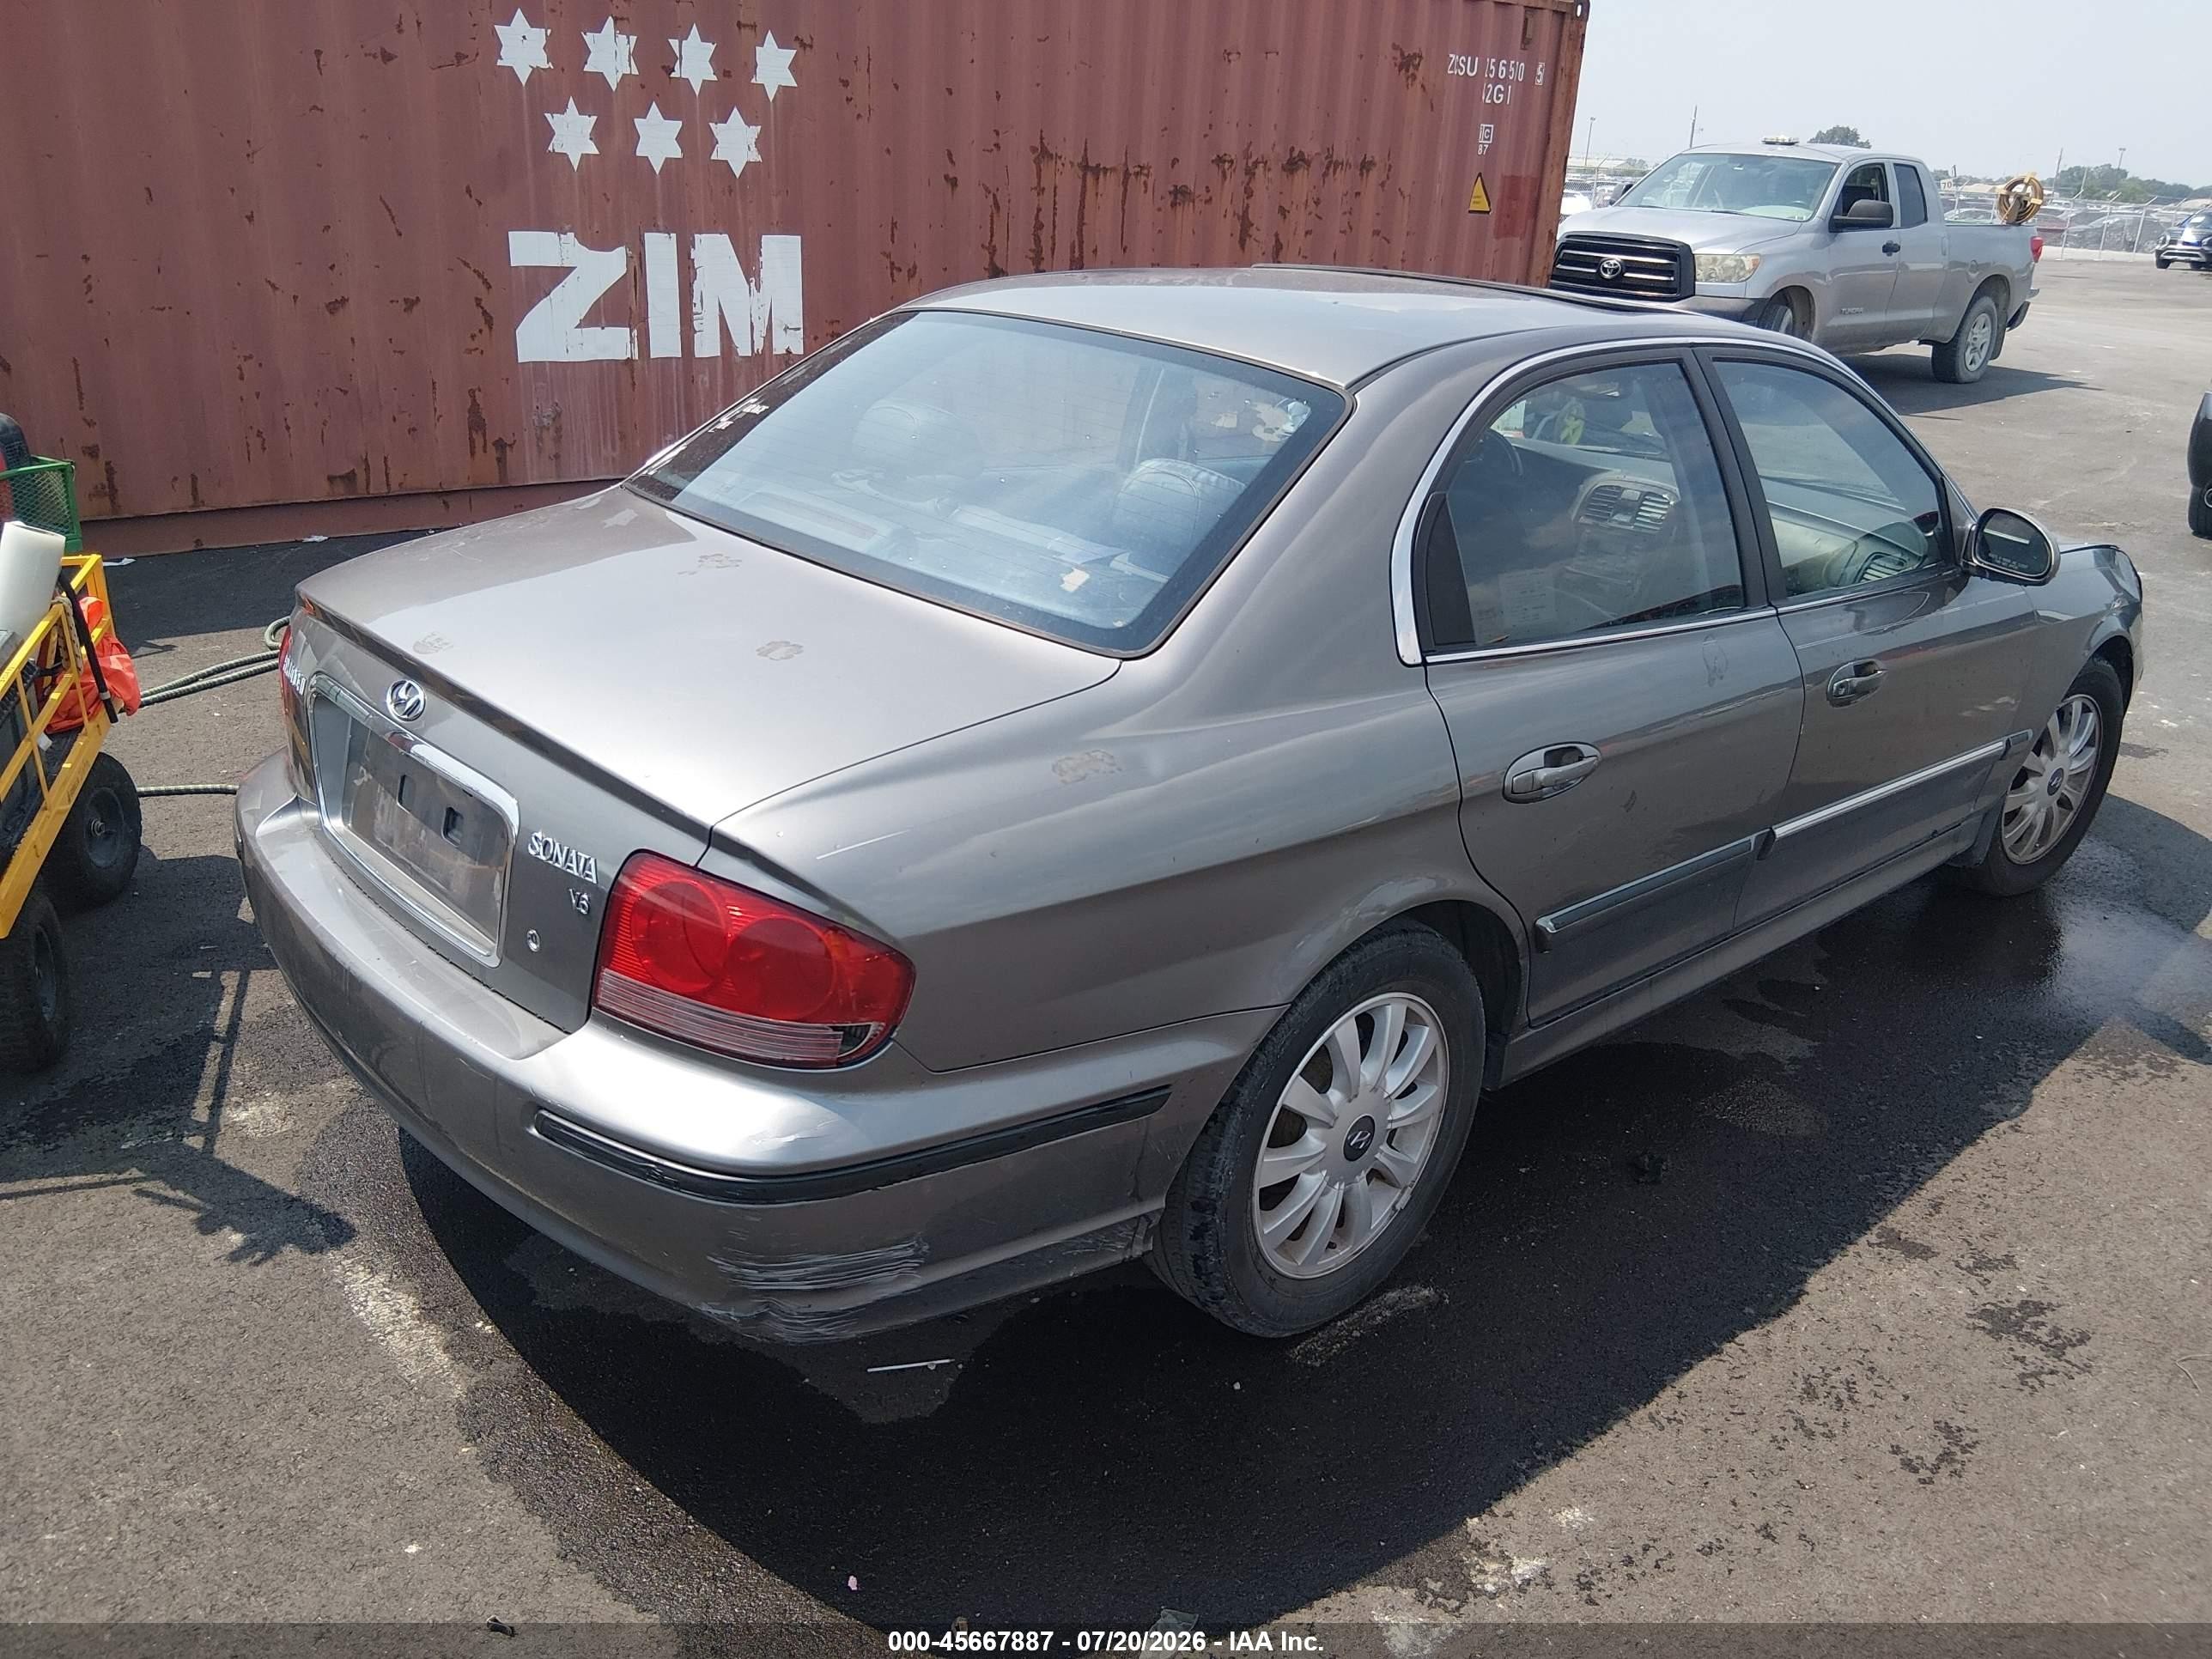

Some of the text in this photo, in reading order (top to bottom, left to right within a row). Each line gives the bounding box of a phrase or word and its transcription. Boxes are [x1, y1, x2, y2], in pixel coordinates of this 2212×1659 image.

[1477, 144, 1489, 155] 87
[507, 230, 805, 362] ZIM
[527, 830, 599, 884] SONATA
[568, 888, 591, 915] V6
